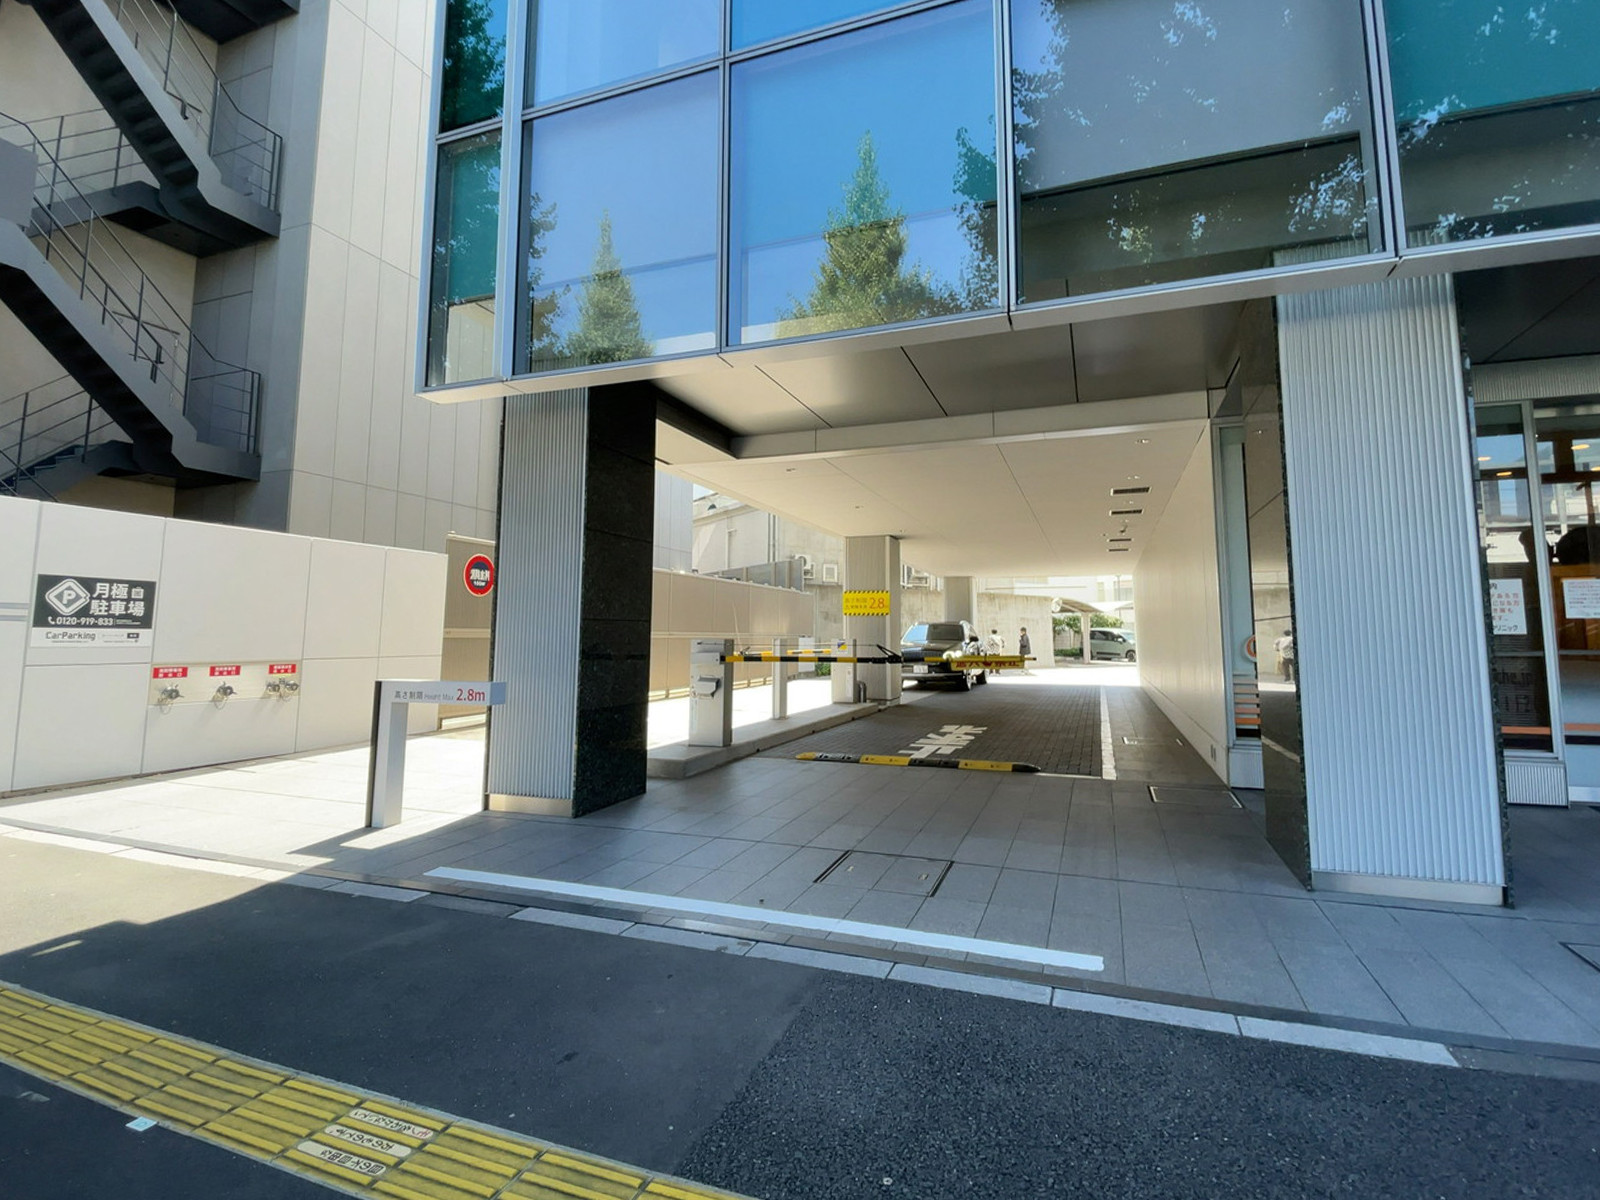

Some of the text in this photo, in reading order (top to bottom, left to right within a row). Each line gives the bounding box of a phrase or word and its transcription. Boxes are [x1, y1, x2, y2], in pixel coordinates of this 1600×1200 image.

[61, 589, 77, 605] P
[92, 582, 129, 599] 月極
[89, 600, 146, 617] 駐車場
[45, 631, 96, 641] CarParking
[456, 688, 486, 702] 2.8m
[319, 1149, 385, 1175] 目の不自由な
